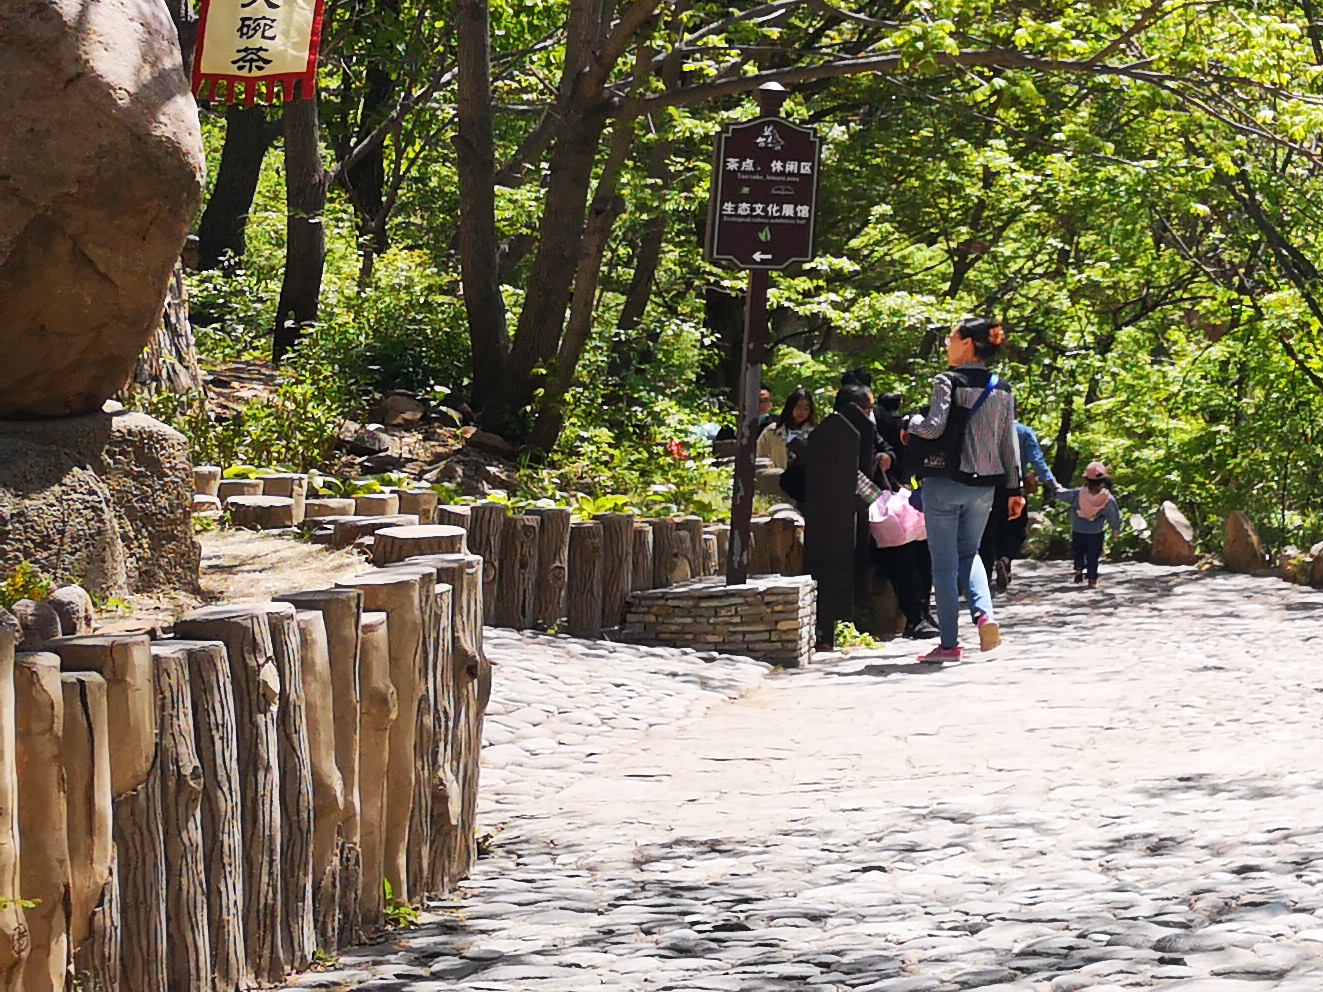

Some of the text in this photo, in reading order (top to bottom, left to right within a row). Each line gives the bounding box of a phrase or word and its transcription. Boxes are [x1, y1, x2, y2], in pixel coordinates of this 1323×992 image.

[722, 201, 809, 217] 生态文化展馆
